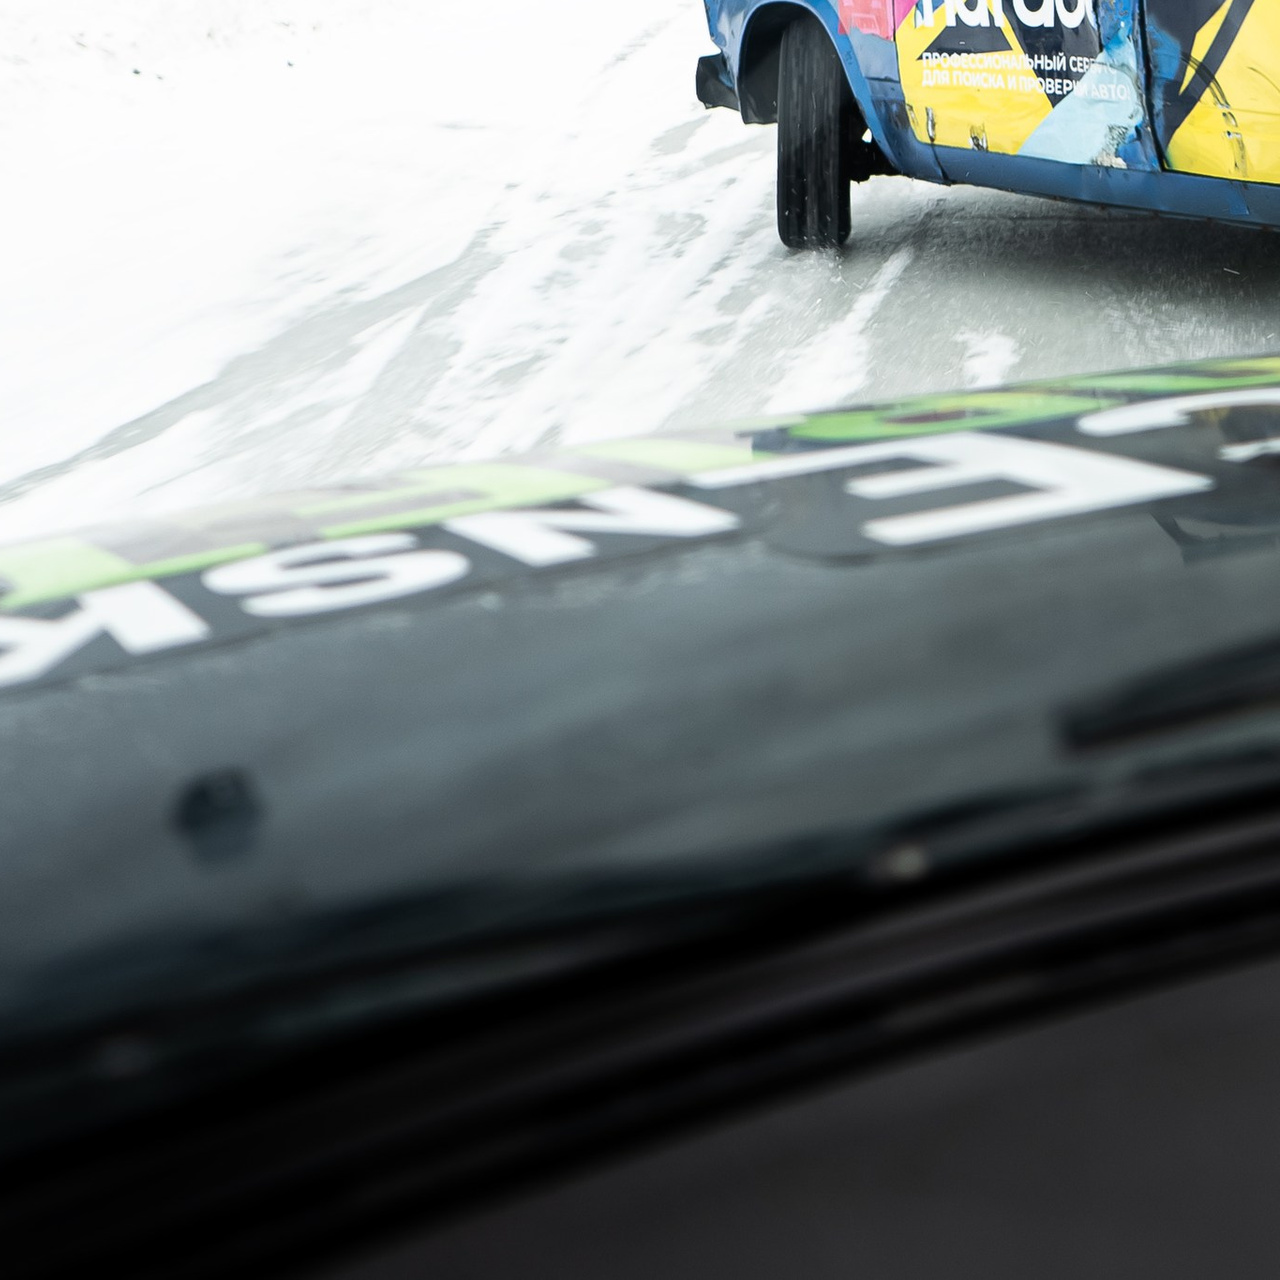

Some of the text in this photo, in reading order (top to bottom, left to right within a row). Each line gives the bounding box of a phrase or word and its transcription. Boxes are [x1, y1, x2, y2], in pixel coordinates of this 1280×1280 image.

[921, 51, 1067, 72] ПРОФЕССИОНАЛЬНЫЙ
[921, 69, 949, 88] ДЛЯ
[952, 71, 1005, 89] ПОИСКА
[1007, 76, 1017, 91] И
